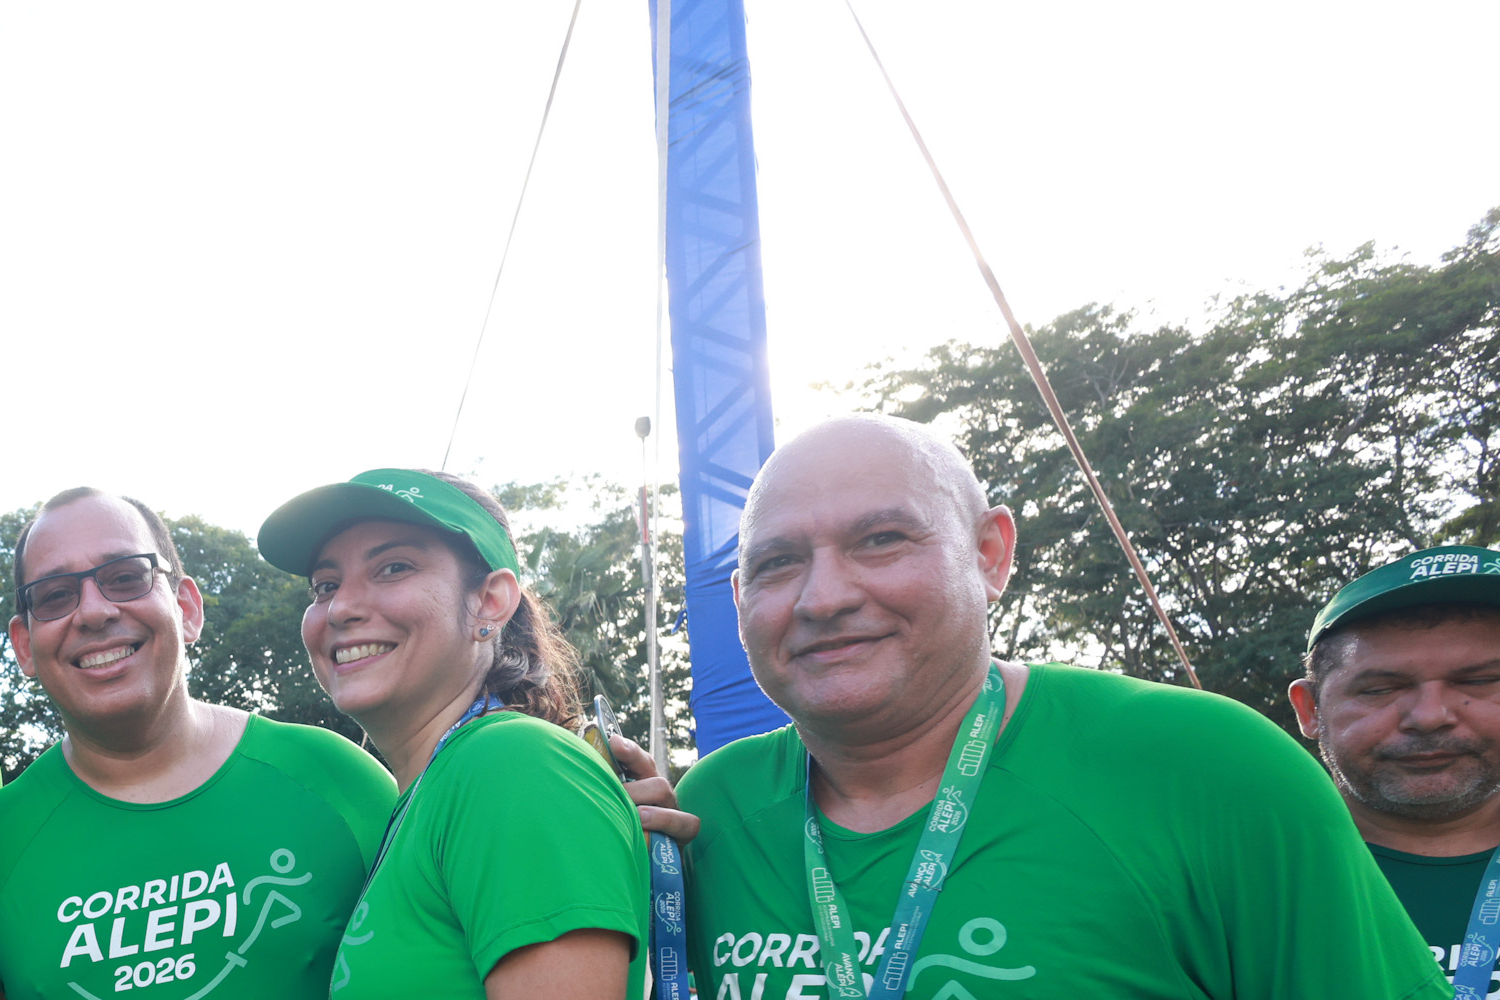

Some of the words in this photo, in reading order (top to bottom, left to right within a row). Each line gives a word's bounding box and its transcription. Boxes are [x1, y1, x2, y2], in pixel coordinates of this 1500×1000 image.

[1409, 562, 1479, 580] ALEPI
[1410, 554, 1479, 568] CORRIDA
[969, 713, 986, 738] ALEPI
[929, 800, 946, 832] CORRIDA
[937, 800, 957, 833] ALEPI
[660, 842, 668, 865] ALEPI
[57, 862, 235, 923] CORRIDA
[908, 862, 929, 898] AVANÇA
[1486, 879, 1498, 898] ALEPI
[666, 892, 675, 921] ALEPI
[674, 891, 682, 922] CORRIDA
[828, 904, 841, 929] ALEPI
[60, 892, 237, 968] ALEPI
[894, 923, 908, 950] ALEPI
[713, 927, 892, 968] CORRDA
[1467, 943, 1482, 967] ALEPI
[114, 953, 196, 992] 2026
[835, 962, 847, 987] ALEPI
[841, 952, 856, 986] AVANÇA
